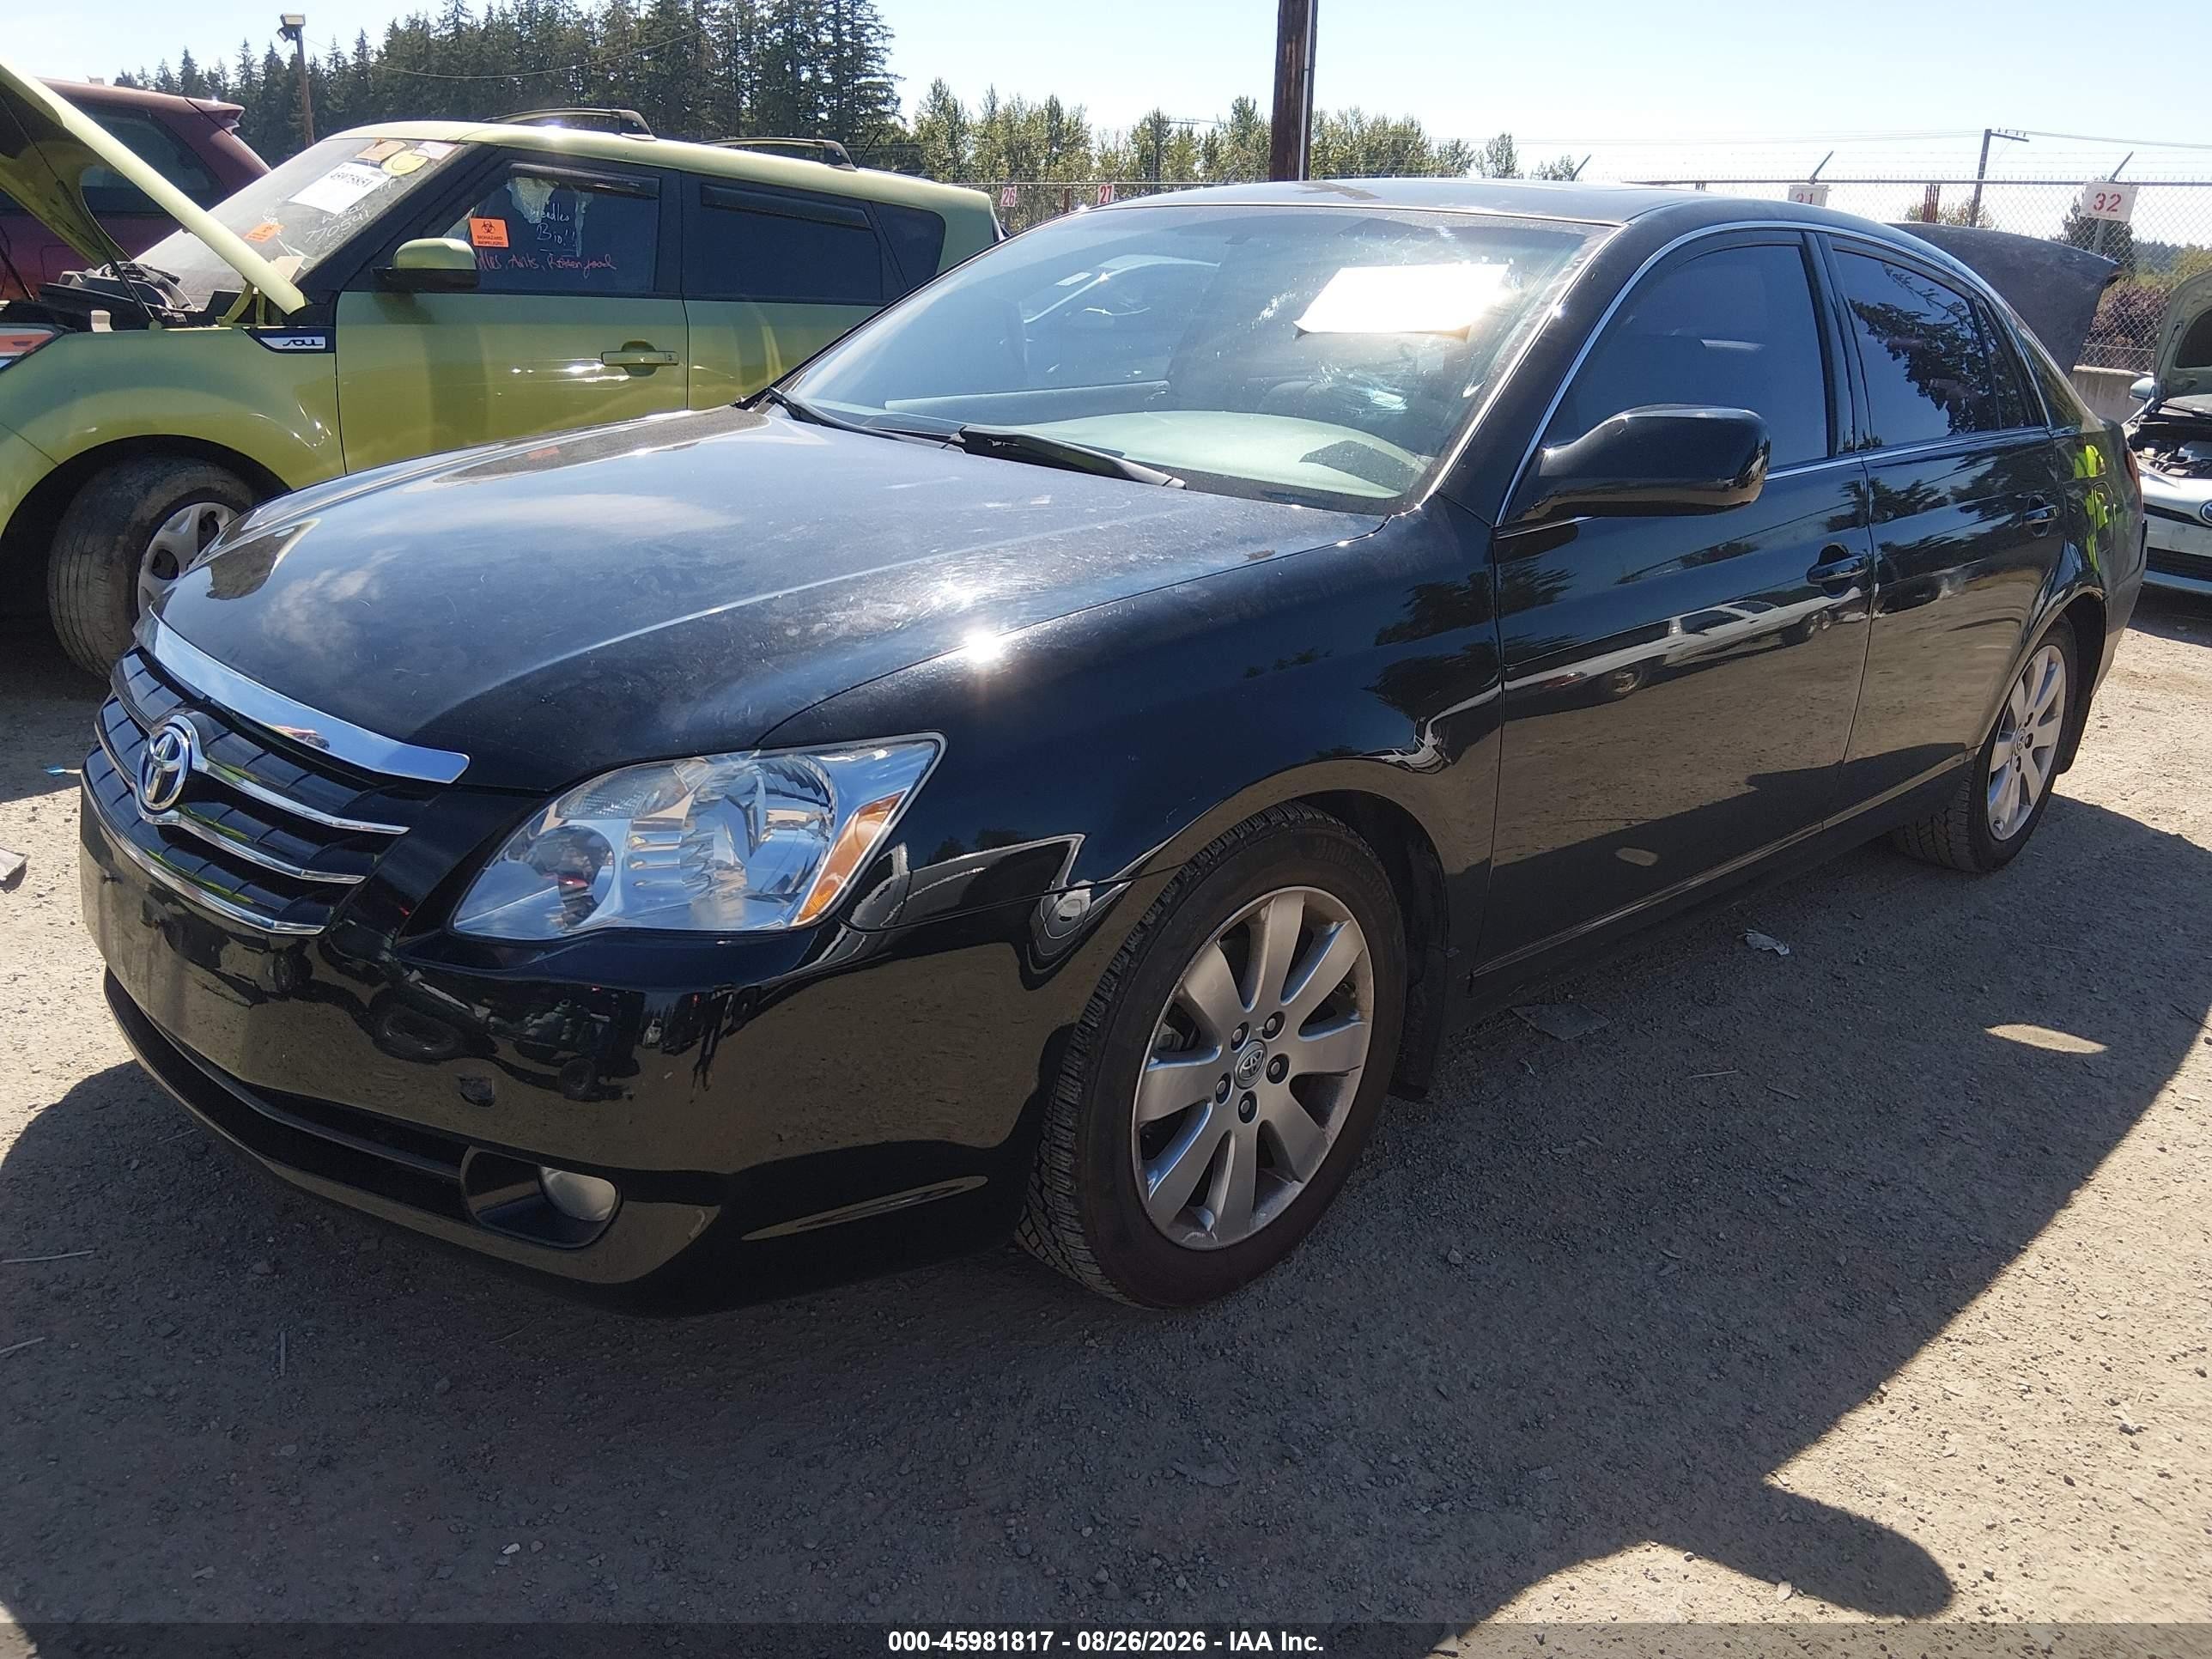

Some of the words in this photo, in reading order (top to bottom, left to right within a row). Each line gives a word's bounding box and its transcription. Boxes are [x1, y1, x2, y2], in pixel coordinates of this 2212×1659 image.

[1002, 188, 1015, 206] 26
[1100, 185, 1112, 204] 27
[2094, 191, 2122, 213] 32
